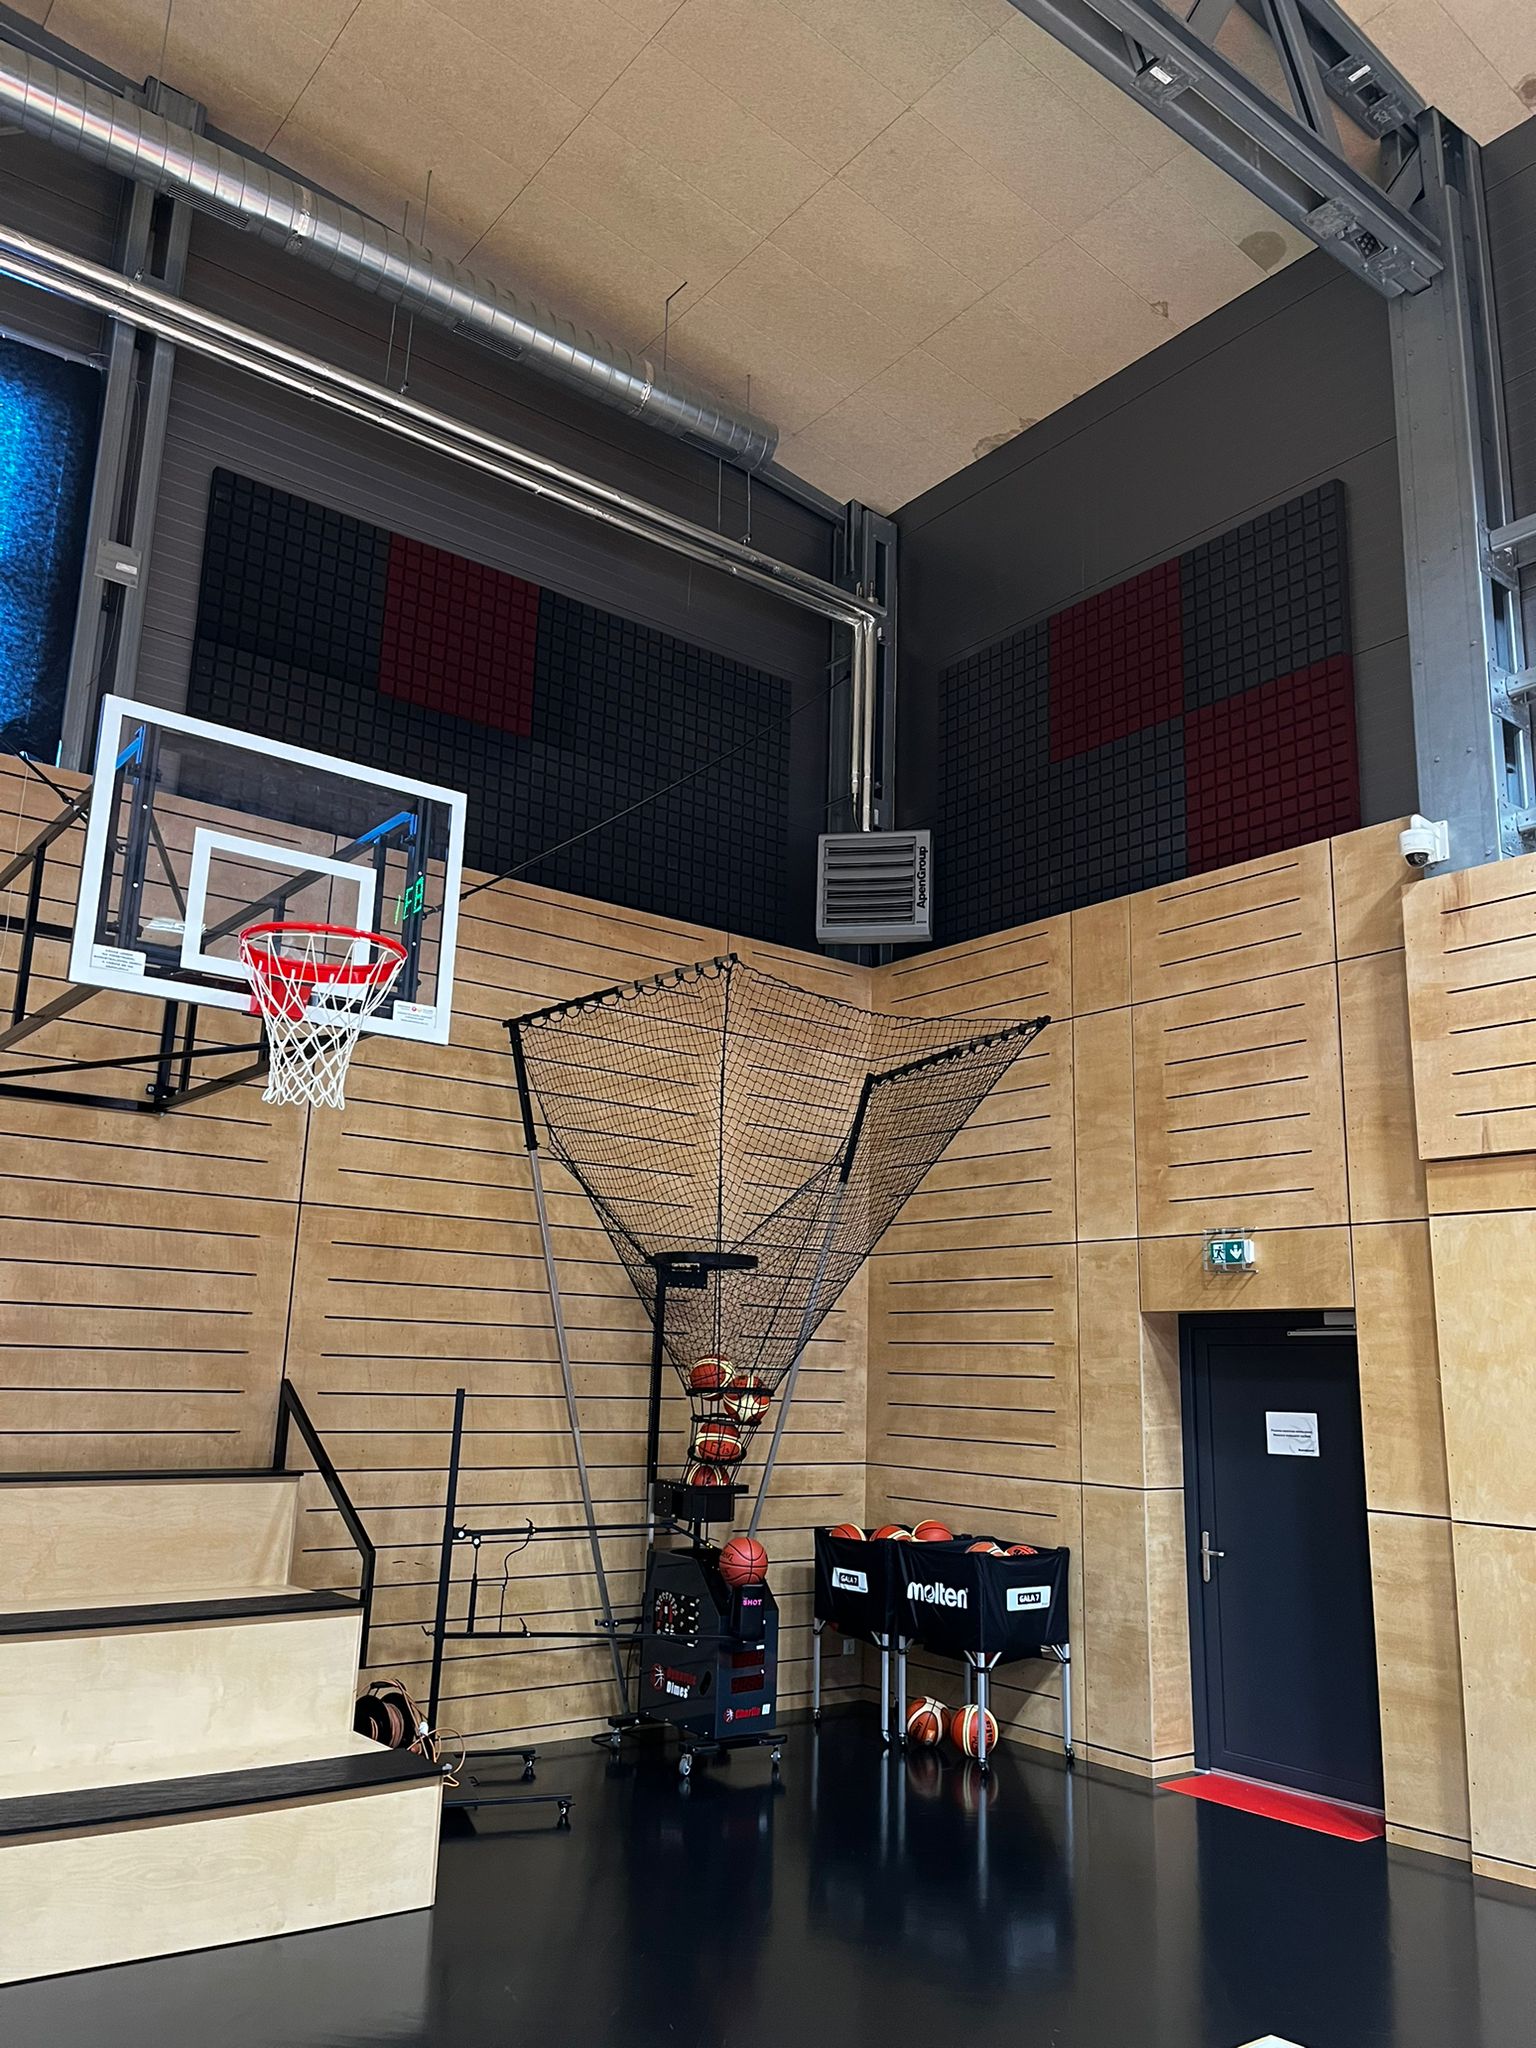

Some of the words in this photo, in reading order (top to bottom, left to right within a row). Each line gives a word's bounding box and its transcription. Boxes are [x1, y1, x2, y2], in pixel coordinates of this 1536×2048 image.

[917, 846, 928, 909] ApenGroup
[907, 1581, 967, 1609] molten
[1019, 1594, 1034, 1604] GALA
[1034, 1593, 1040, 1602] 7
